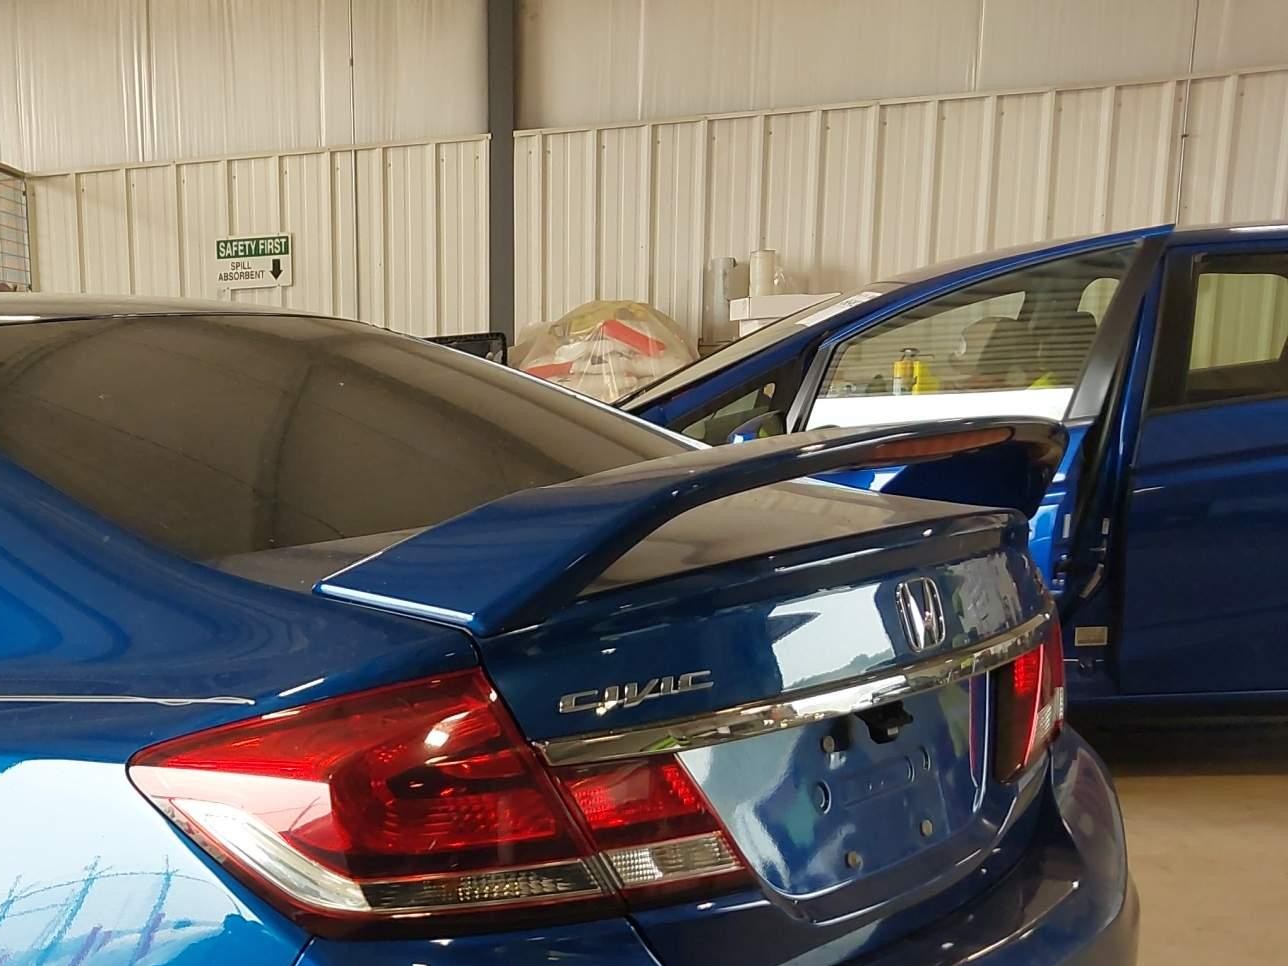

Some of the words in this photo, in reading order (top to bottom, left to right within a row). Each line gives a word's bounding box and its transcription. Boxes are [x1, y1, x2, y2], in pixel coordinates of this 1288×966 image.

[219, 240, 257, 257] SAFETY
[259, 238, 287, 254] FIRST
[230, 261, 252, 271] SPILL
[218, 269, 265, 282] ABSORBENT
[559, 669, 714, 716] CIVIC
